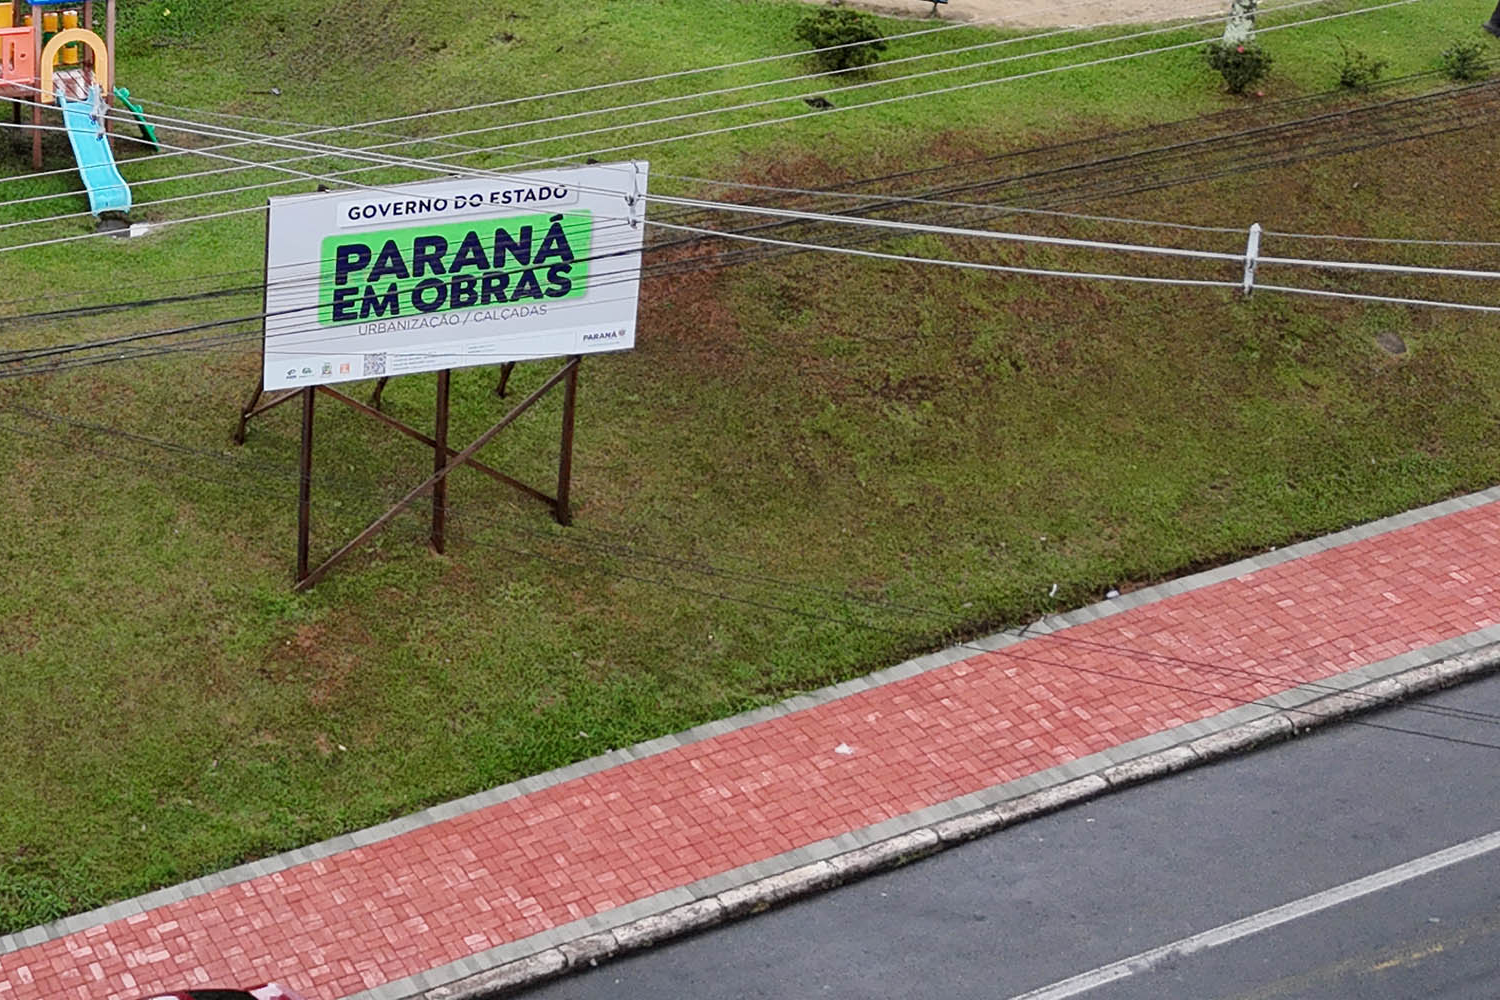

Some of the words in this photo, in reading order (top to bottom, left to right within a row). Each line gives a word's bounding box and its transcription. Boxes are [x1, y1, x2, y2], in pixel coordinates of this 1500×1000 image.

[348, 199, 448, 220] GOVERNO
[454, 194, 484, 209] DO
[489, 185, 568, 205] ESTADO
[335, 213, 575, 285] PARANÁ
[332, 282, 400, 321] EM
[411, 263, 573, 313] OBRAS
[358, 312, 460, 336] URBANIZAÇÃO
[462, 311, 472, 326] /
[473, 304, 548, 323] CALÇADAS
